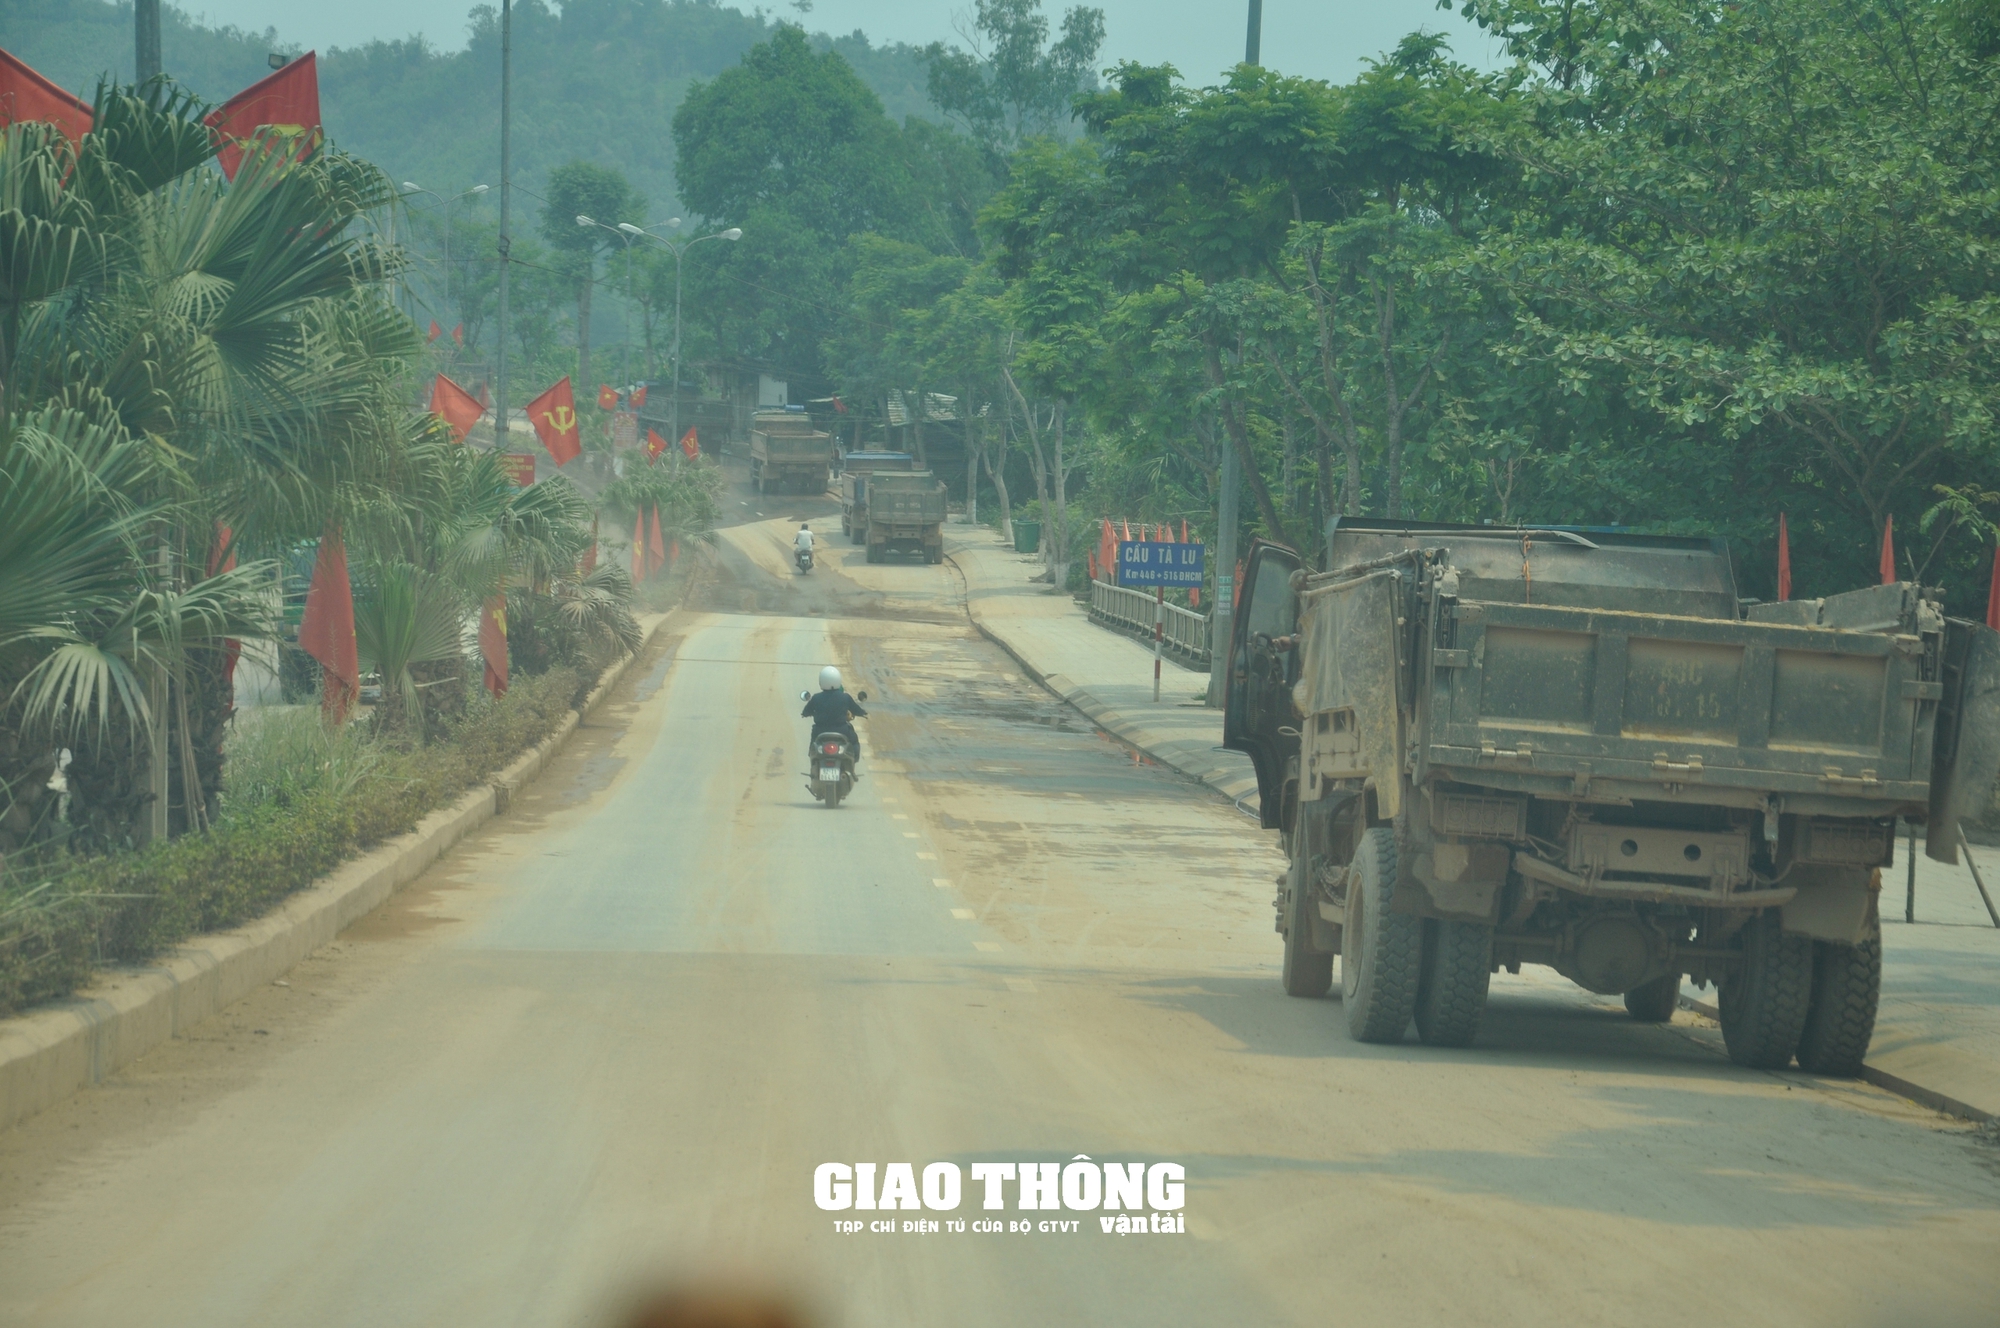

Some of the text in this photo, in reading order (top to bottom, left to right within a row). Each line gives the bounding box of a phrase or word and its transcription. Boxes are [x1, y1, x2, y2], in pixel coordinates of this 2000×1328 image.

[1125, 543, 1196, 565] CẦU TÀ LU
